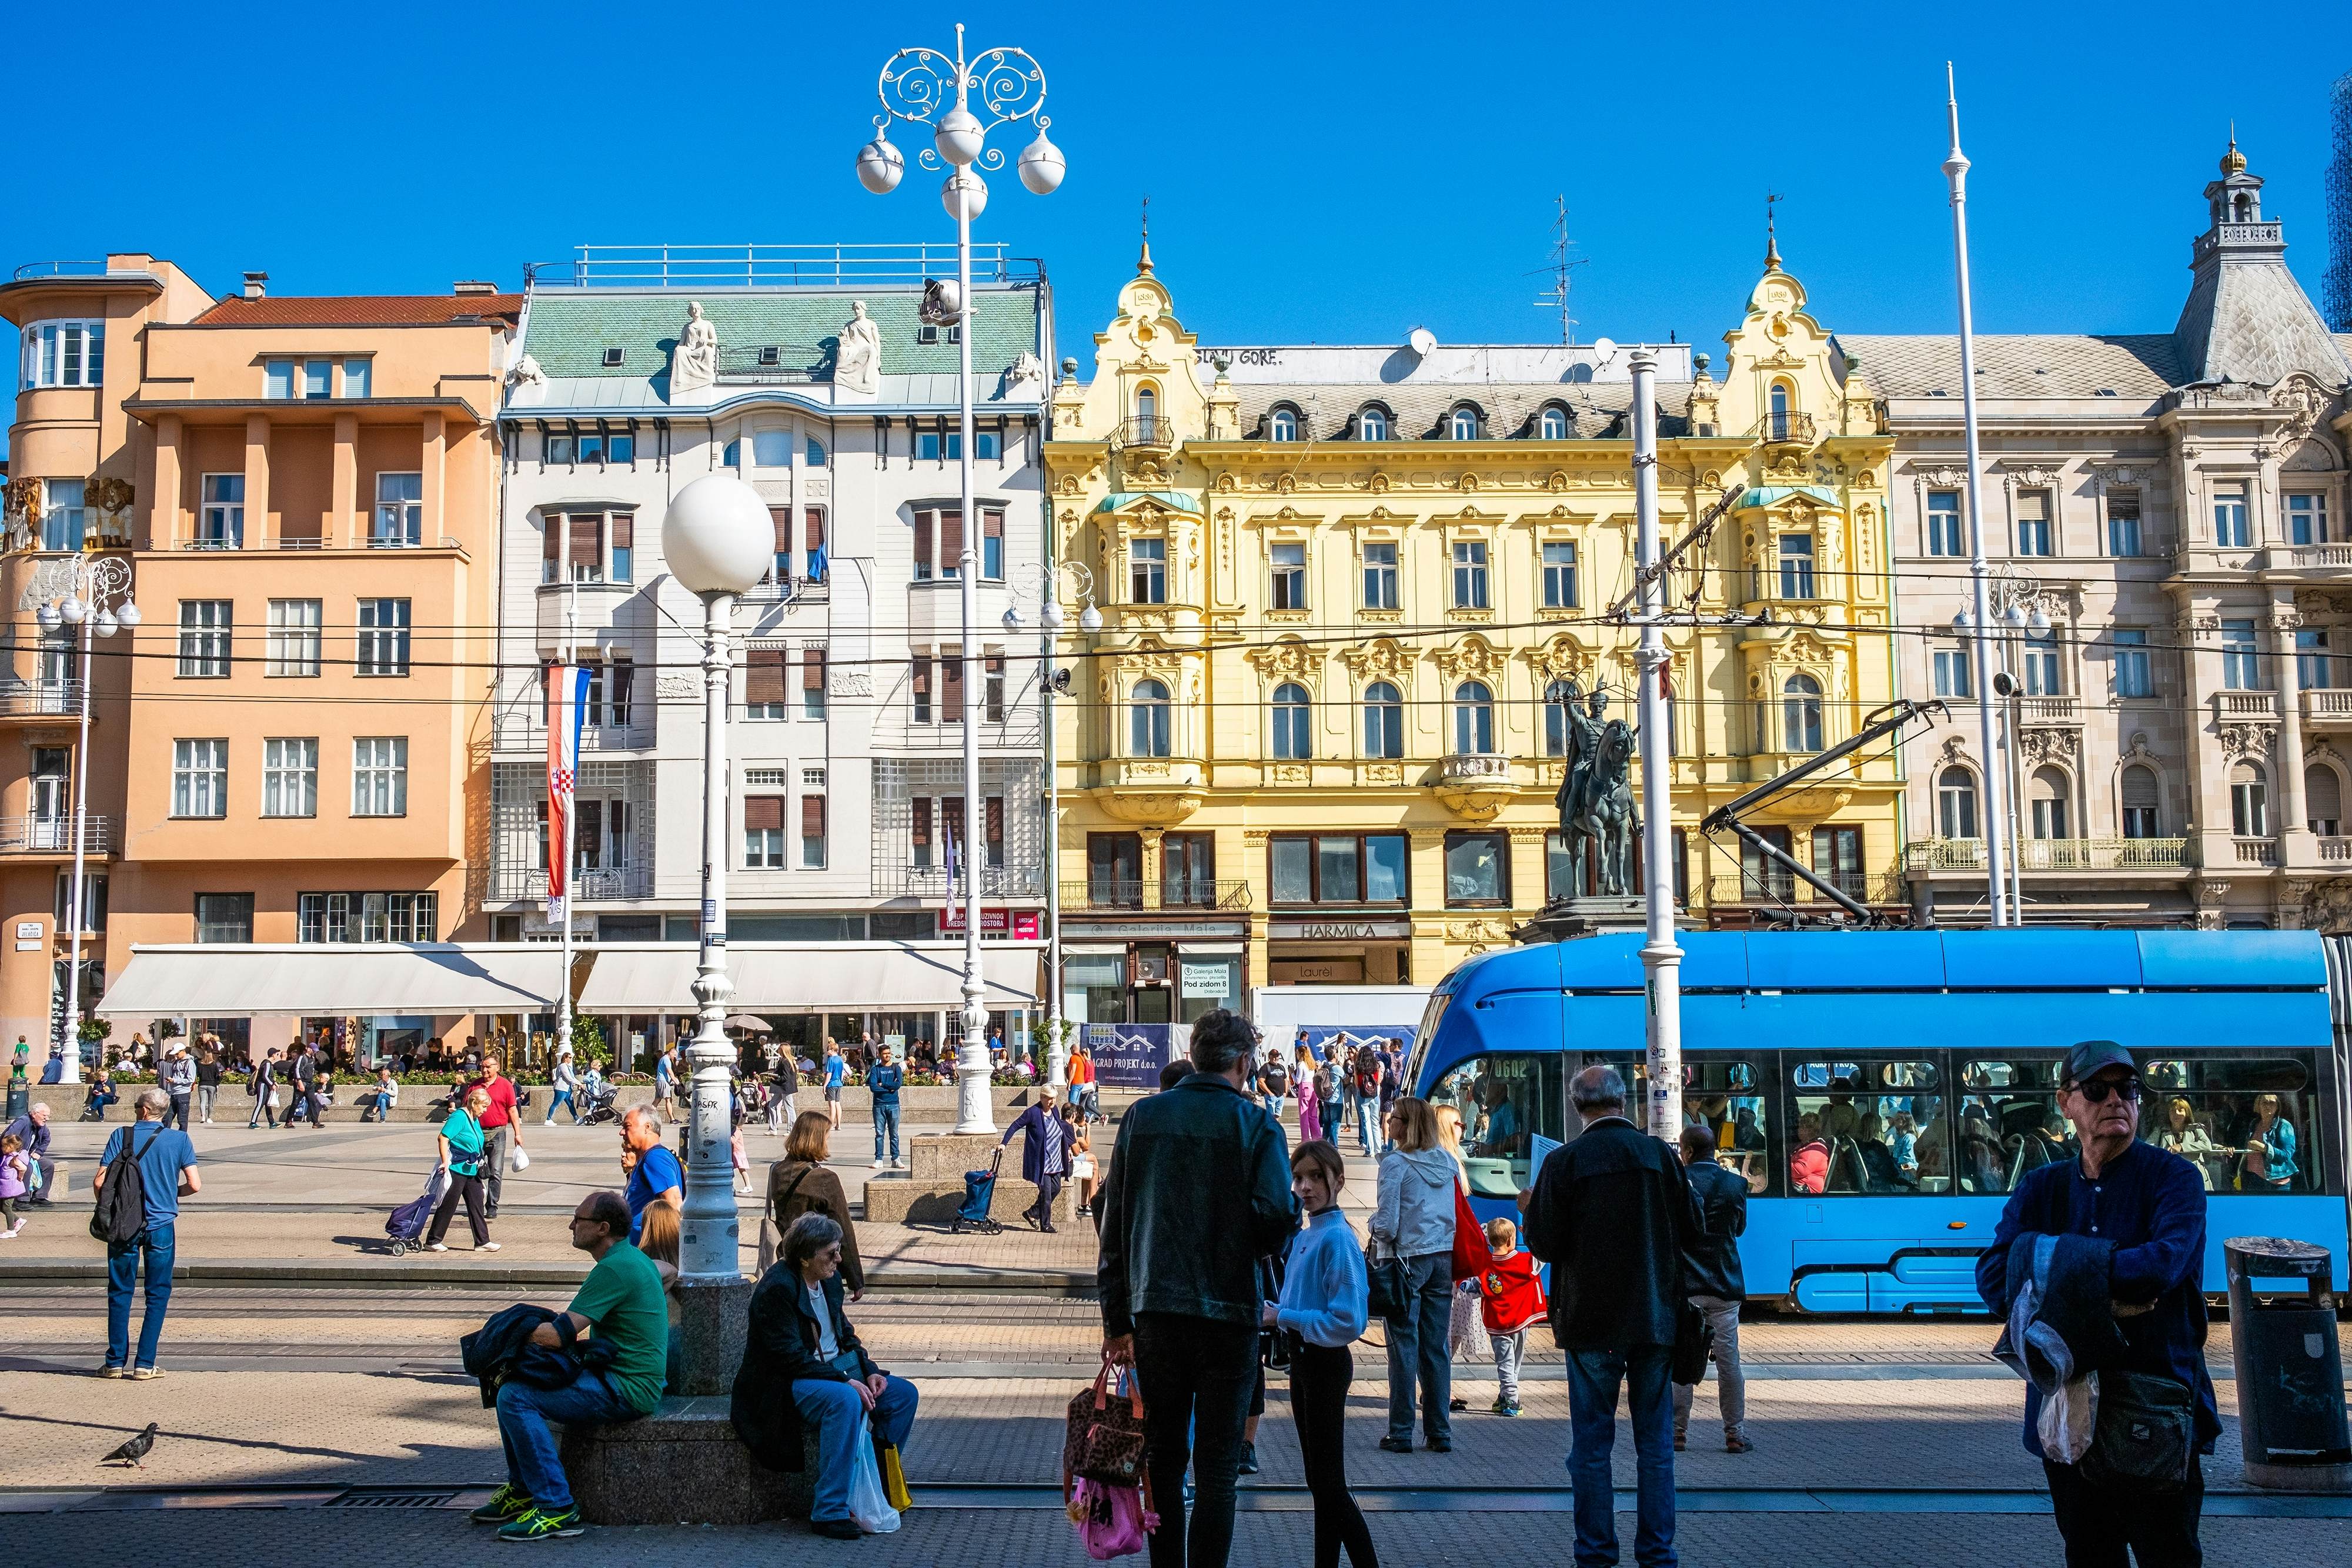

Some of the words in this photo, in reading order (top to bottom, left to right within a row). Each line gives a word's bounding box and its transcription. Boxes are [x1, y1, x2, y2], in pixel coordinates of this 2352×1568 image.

[1239, 349, 1283, 366] GORE.
[1118, 924, 1172, 935] Galerija
[1184, 924, 1217, 935] Mala
[1302, 924, 1376, 938] HARMICA
[1300, 965, 1332, 977] Laurèl
[1114, 1058, 1140, 1070] PROJEKT
[1141, 1059, 1157, 1069] d.o.o.
[1495, 1059, 1527, 1078] 0602
